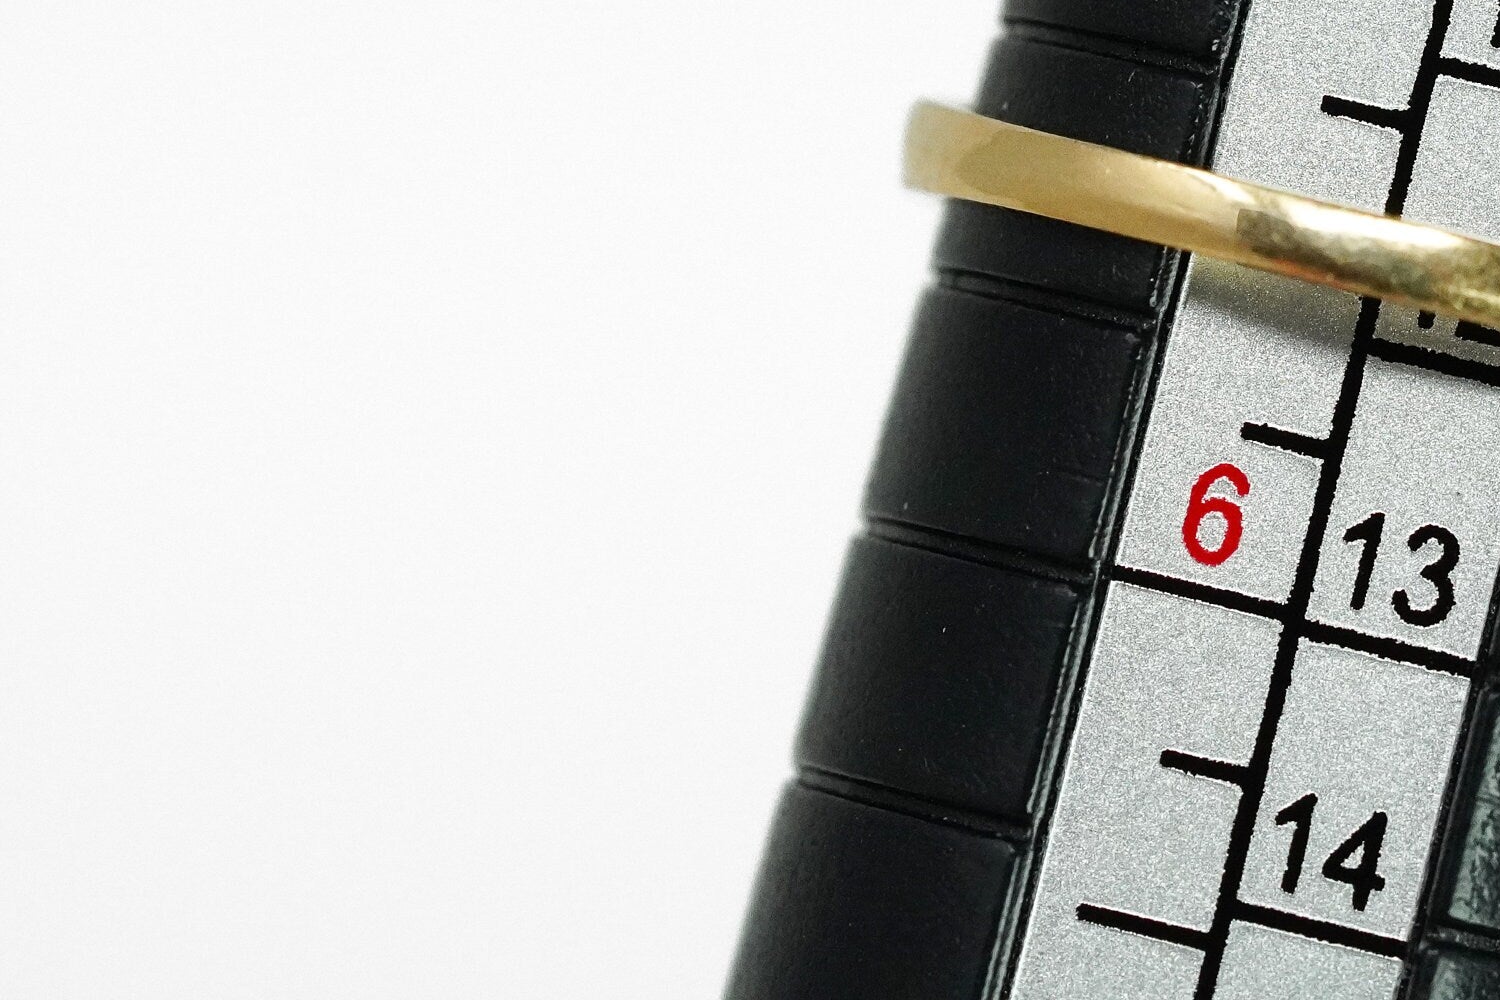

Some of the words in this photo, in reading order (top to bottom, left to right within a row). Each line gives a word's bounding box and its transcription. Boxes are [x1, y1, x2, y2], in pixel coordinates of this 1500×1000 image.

[1182, 464, 1250, 567] 6
[1343, 513, 1460, 627] 13
[1275, 793, 1388, 911] 14
